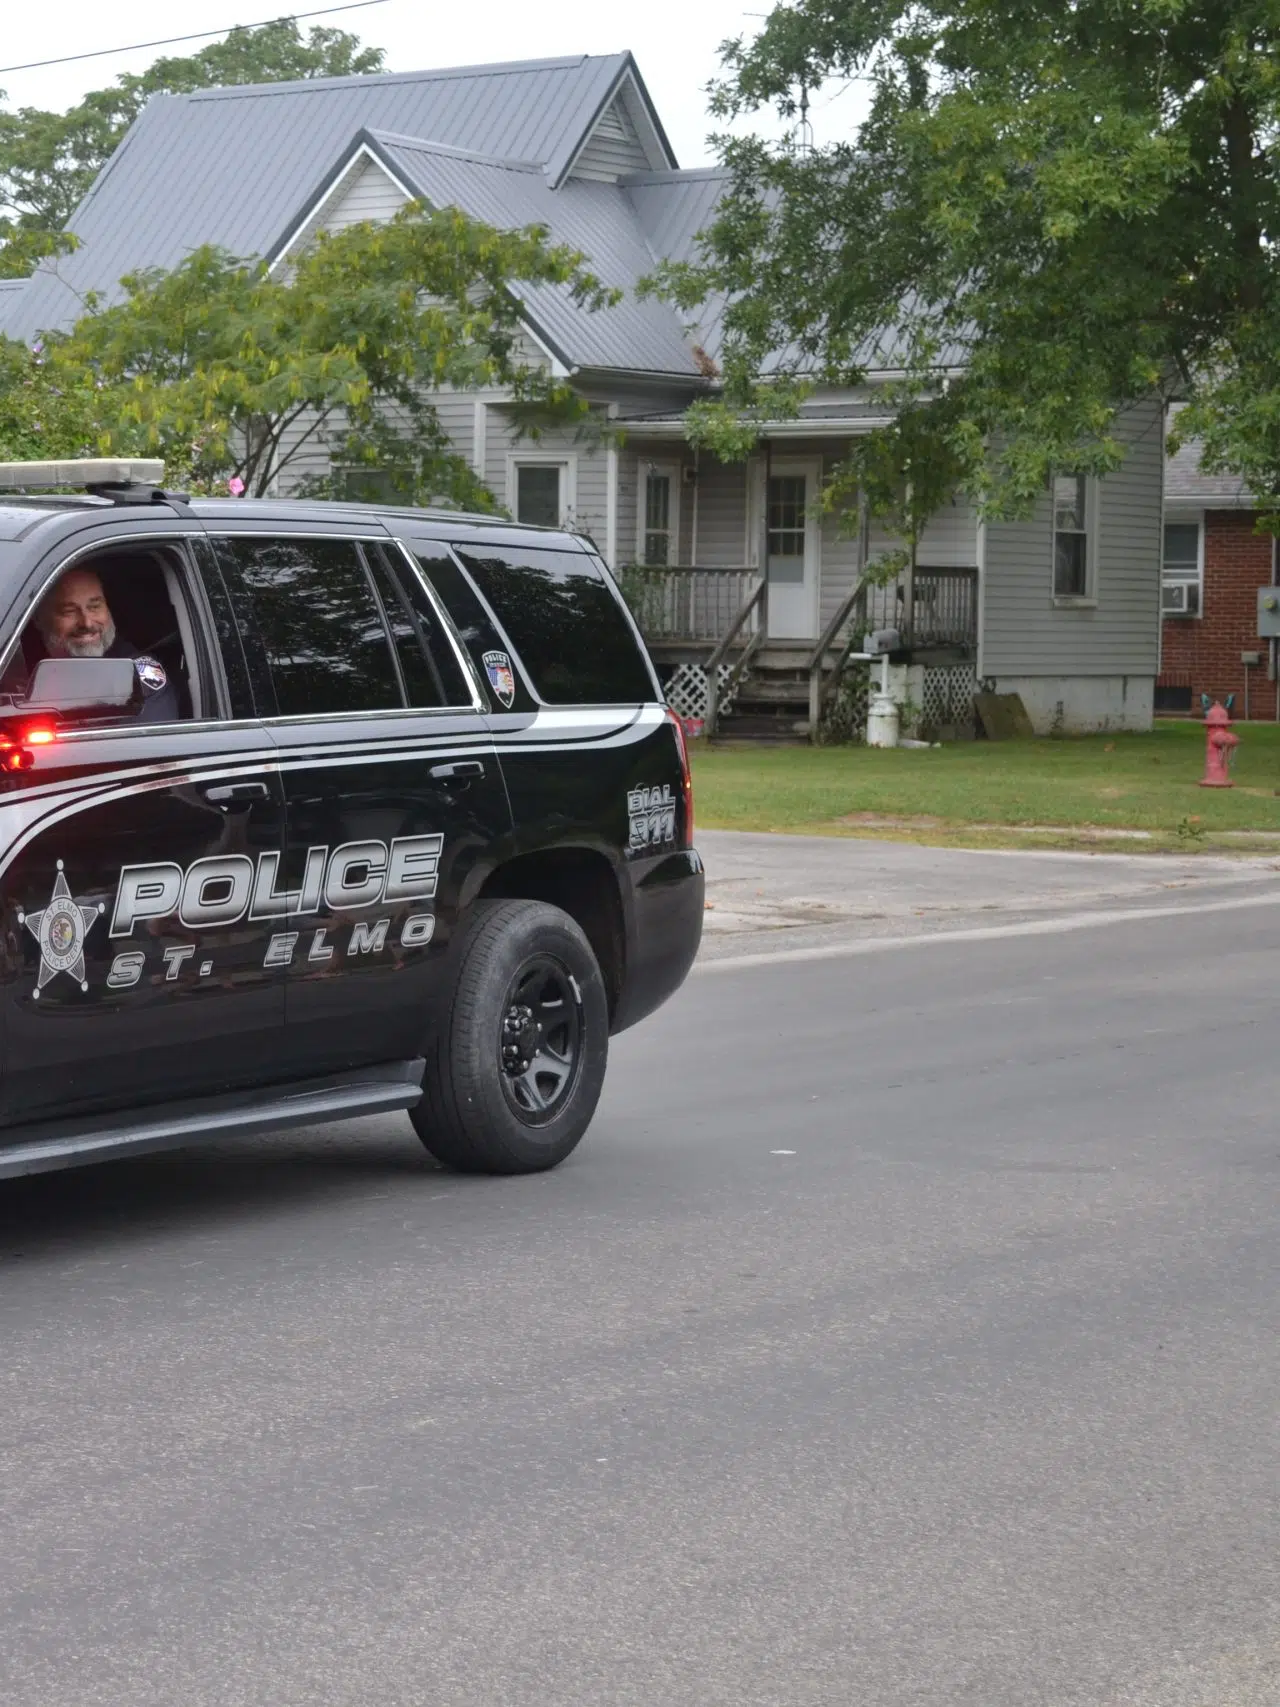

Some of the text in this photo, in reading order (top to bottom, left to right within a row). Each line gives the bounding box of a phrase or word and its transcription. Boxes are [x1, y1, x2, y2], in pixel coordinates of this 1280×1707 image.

[627, 784, 676, 816] DIAL
[629, 806, 675, 849] 911
[109, 833, 444, 938] POLICE
[57, 901, 78, 919] ELMO
[42, 939, 65, 968] POLICE
[107, 913, 435, 988] ST. ELMO
